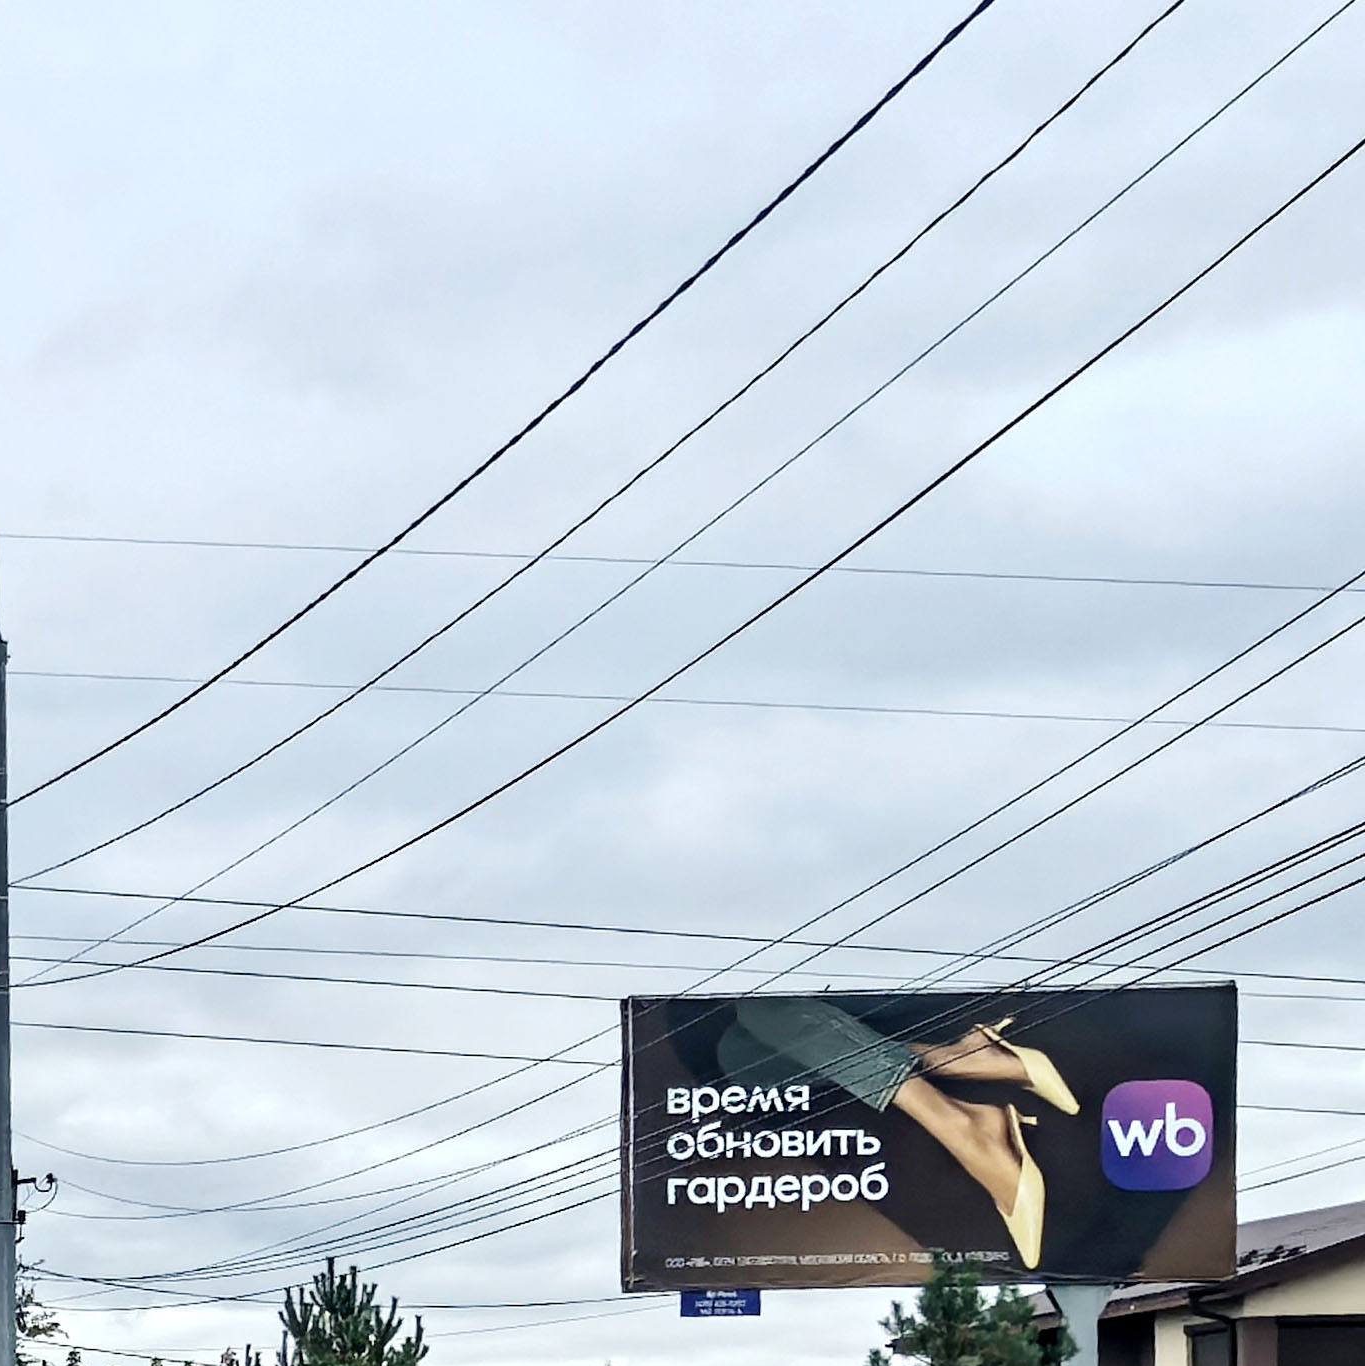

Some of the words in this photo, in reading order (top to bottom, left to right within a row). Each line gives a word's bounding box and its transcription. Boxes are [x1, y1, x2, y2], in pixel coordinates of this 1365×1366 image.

[667, 1085, 810, 1123] время
[666, 1121, 882, 1160] обновить
[1107, 1102, 1206, 1157] wb
[667, 1162, 889, 1213] гардероб
